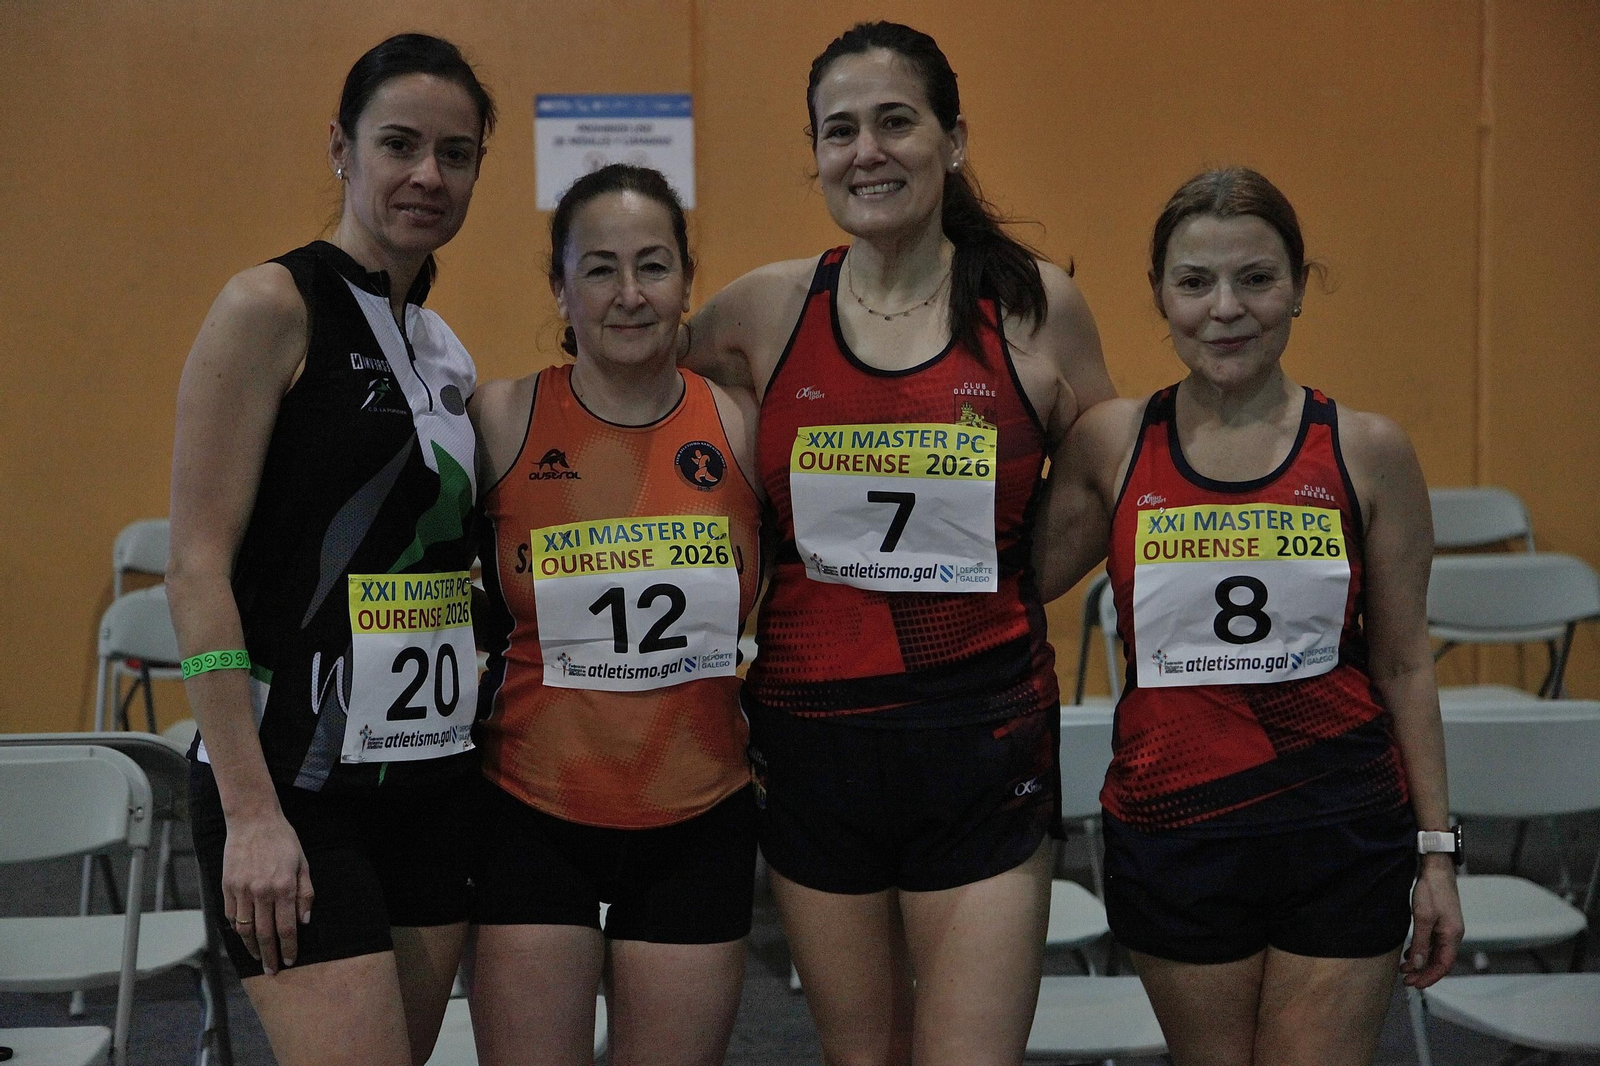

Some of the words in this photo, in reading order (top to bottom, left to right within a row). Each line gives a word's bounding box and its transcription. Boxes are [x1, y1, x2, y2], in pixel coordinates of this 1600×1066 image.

[953, 388, 996, 398] OURENSE
[963, 381, 987, 390] CLUB
[808, 431, 843, 449] XXI
[852, 430, 948, 449] MASTER
[956, 432, 985, 453] PC
[799, 451, 910, 474] OURENSE
[926, 453, 990, 477] 2026
[1294, 489, 1336, 502] OURENSE
[1304, 484, 1327, 494] CLUB
[867, 491, 916, 552] 7
[1149, 513, 1185, 534] XXI
[1193, 510, 1295, 531] MASTER
[1302, 513, 1332, 532] PC
[543, 529, 580, 552] XXI
[589, 522, 687, 545] MASTER
[693, 521, 719, 541] PC
[1143, 537, 1260, 560] OURENSE
[1276, 535, 1340, 557] 2026
[541, 549, 654, 575] OURENSE
[669, 545, 729, 566] 2026
[960, 567, 993, 575] DEPORTE
[840, 562, 938, 582] atletismo.gal
[960, 575, 990, 583] GALEGO
[360, 581, 396, 602] XXI
[404, 577, 455, 601] MASTER
[456, 577, 471, 597] PC
[358, 607, 441, 630] OURENSE
[445, 601, 470, 625] 2026
[588, 583, 688, 654] 12
[1213, 575, 1272, 645] 8
[588, 658, 683, 679] atletismo.gal
[702, 660, 730, 669] GALEGO
[1186, 652, 1289, 672] atletismo.gal
[1307, 655, 1334, 665] GALEGO
[386, 643, 460, 721] 20
